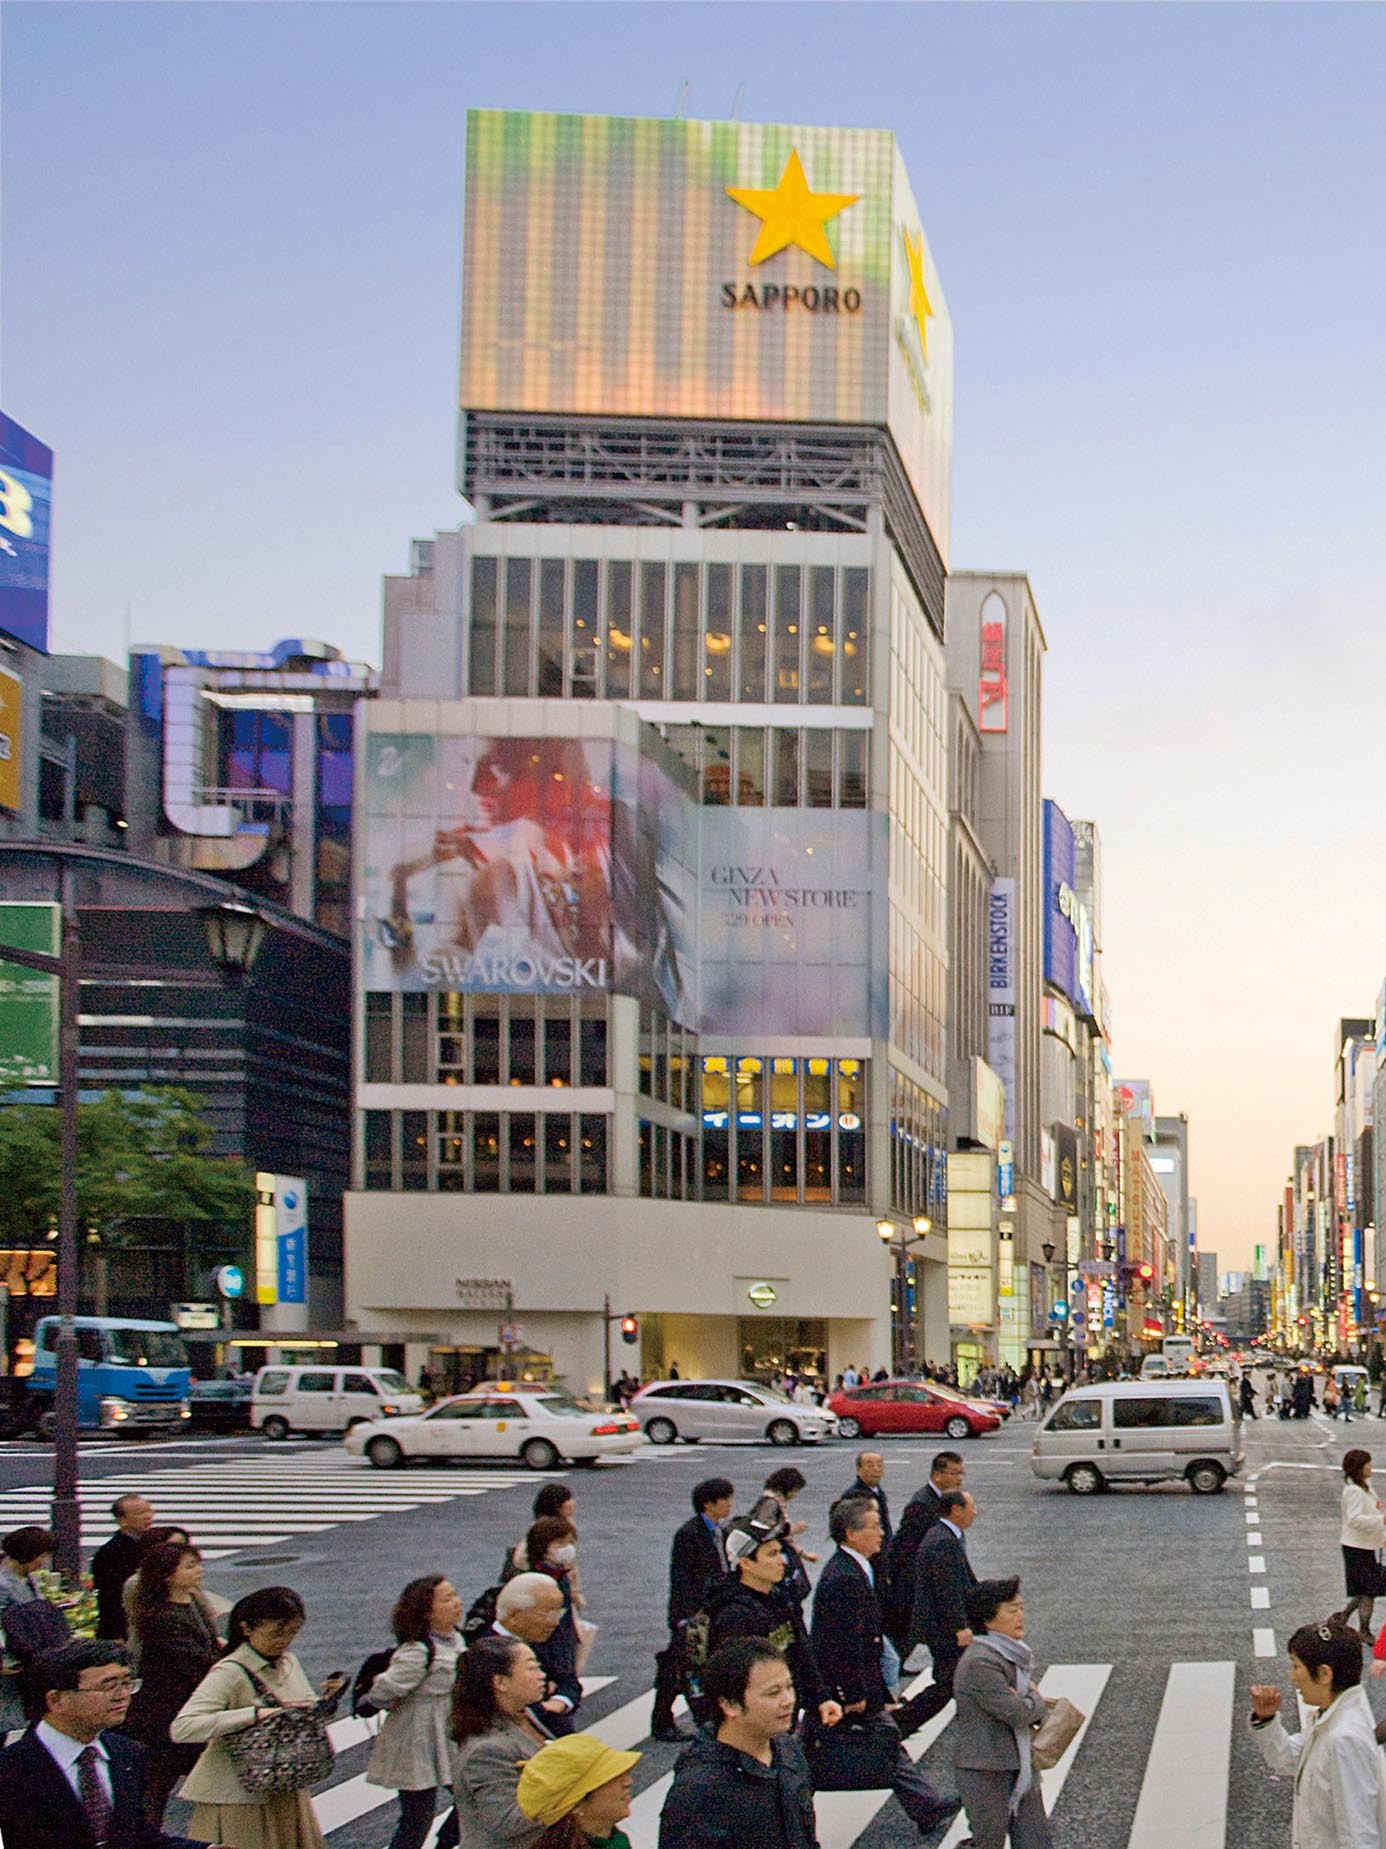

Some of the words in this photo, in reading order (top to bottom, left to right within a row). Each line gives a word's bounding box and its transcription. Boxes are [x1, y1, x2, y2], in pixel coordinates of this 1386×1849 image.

[721, 281, 861, 313] SAPPORO
[711, 866, 779, 885] GINZA
[784, 889, 857, 908] STORE
[989, 893, 1008, 989] BIRKENSTOCK
[421, 955, 608, 987] SWAROVSKI
[703, 1112, 830, 1129] イーオン
[456, 1279, 511, 1289] NISSAN
